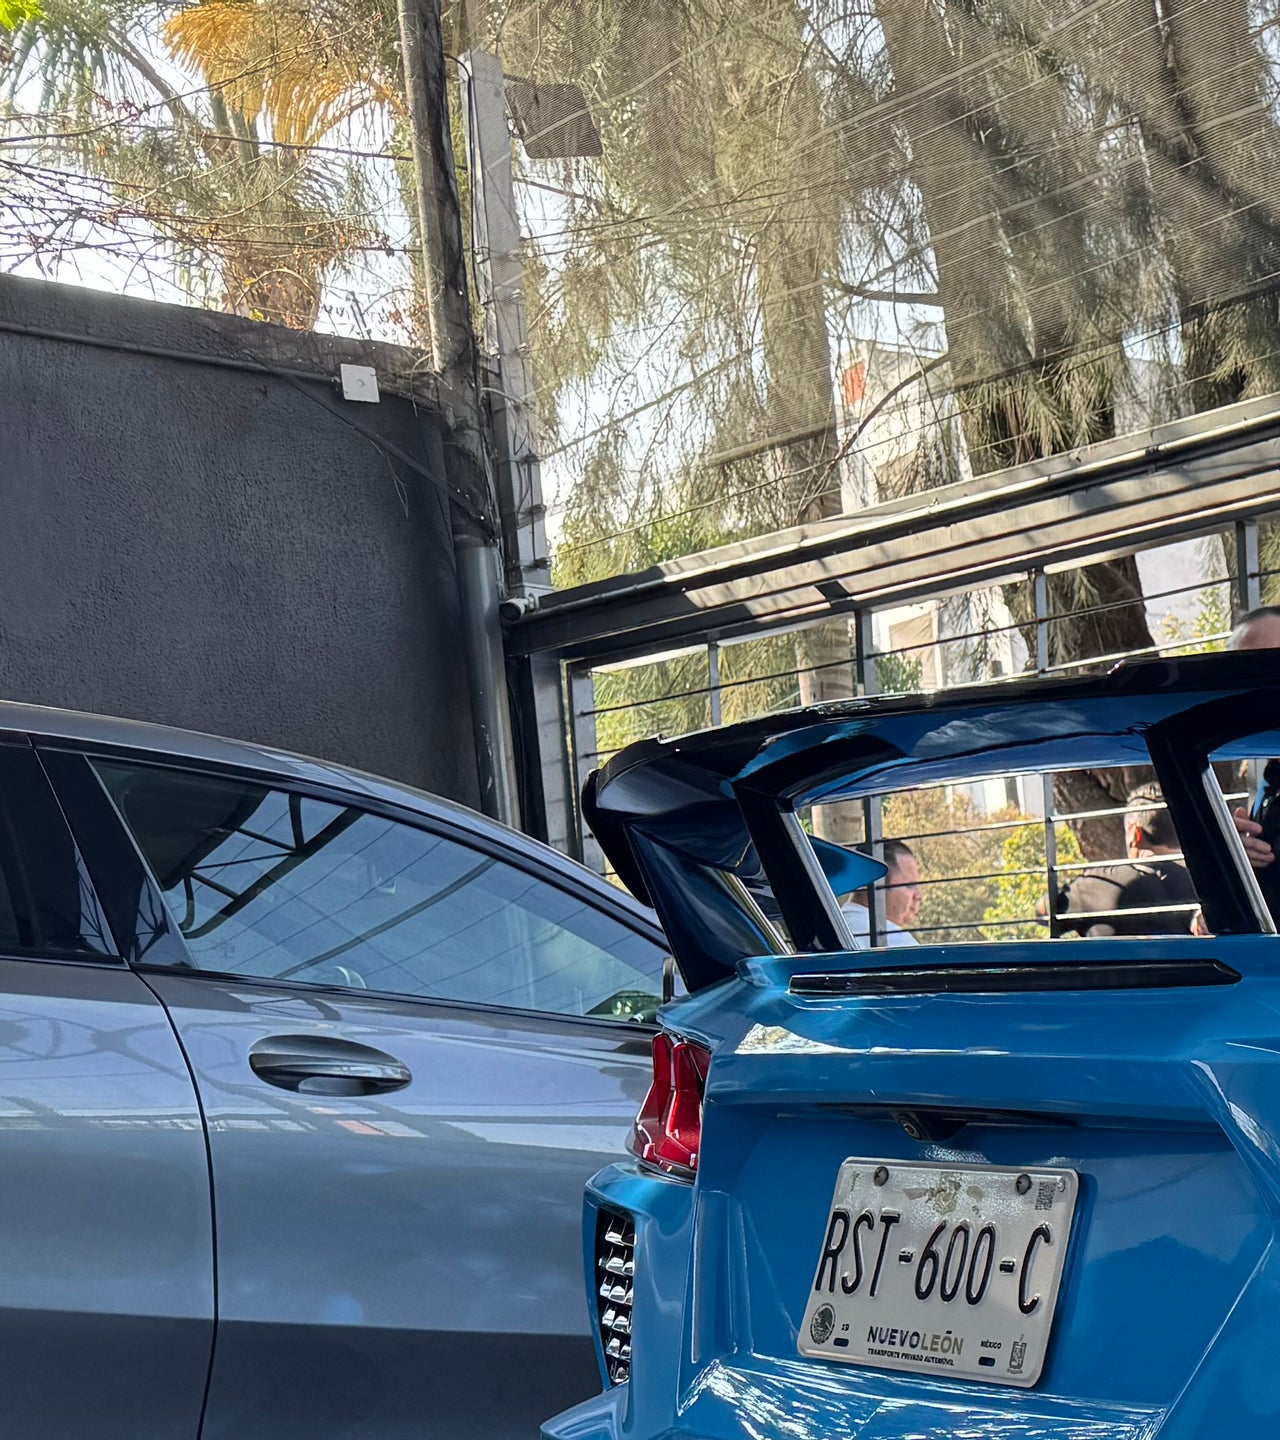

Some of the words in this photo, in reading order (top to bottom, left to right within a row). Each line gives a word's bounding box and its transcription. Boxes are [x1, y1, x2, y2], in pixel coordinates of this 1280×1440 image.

[815, 1207, 1052, 1314] RST-600-C
[841, 1323, 850, 1332] 19
[980, 1338, 1003, 1350] MÉXICO
